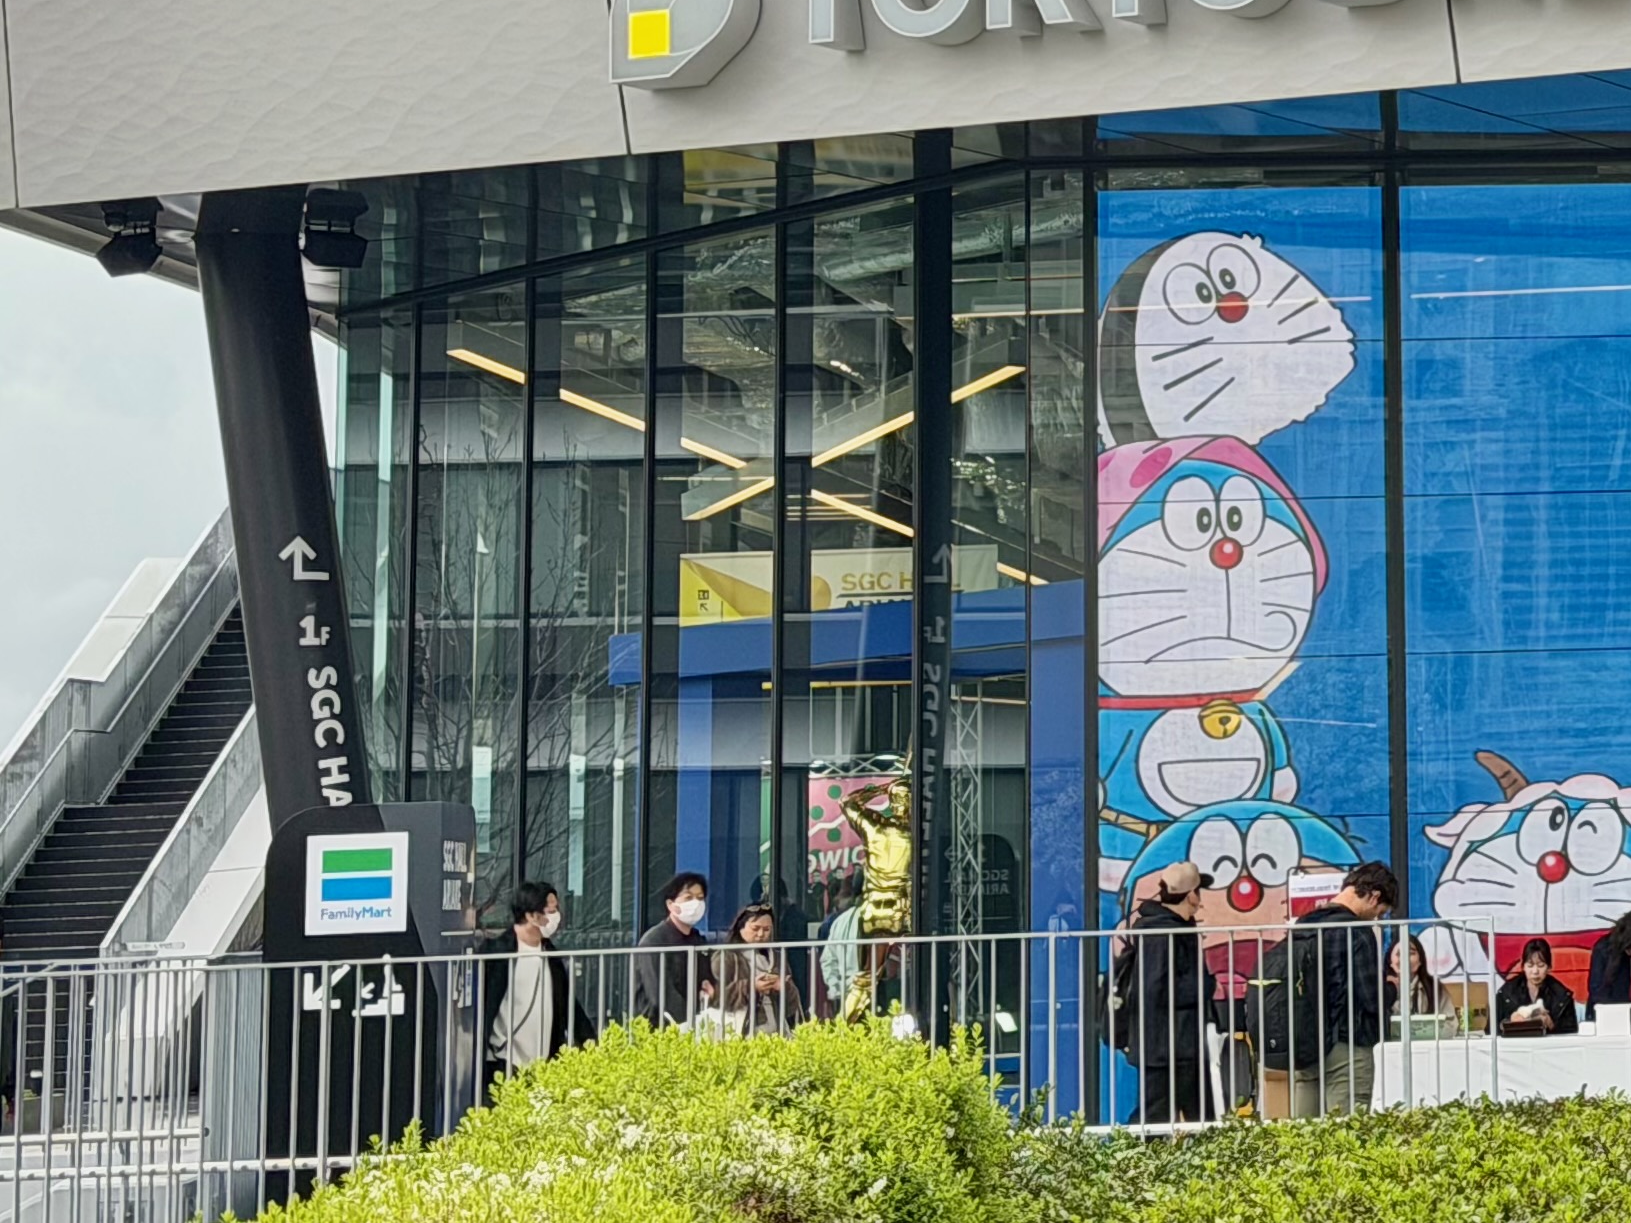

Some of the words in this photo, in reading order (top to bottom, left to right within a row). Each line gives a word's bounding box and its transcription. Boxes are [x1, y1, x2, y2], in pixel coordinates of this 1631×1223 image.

[841, 571, 893, 591] SGC
[299, 615, 331, 646] 1F
[308, 666, 345, 749] SGC
[320, 906, 392, 921] FamilyMart
